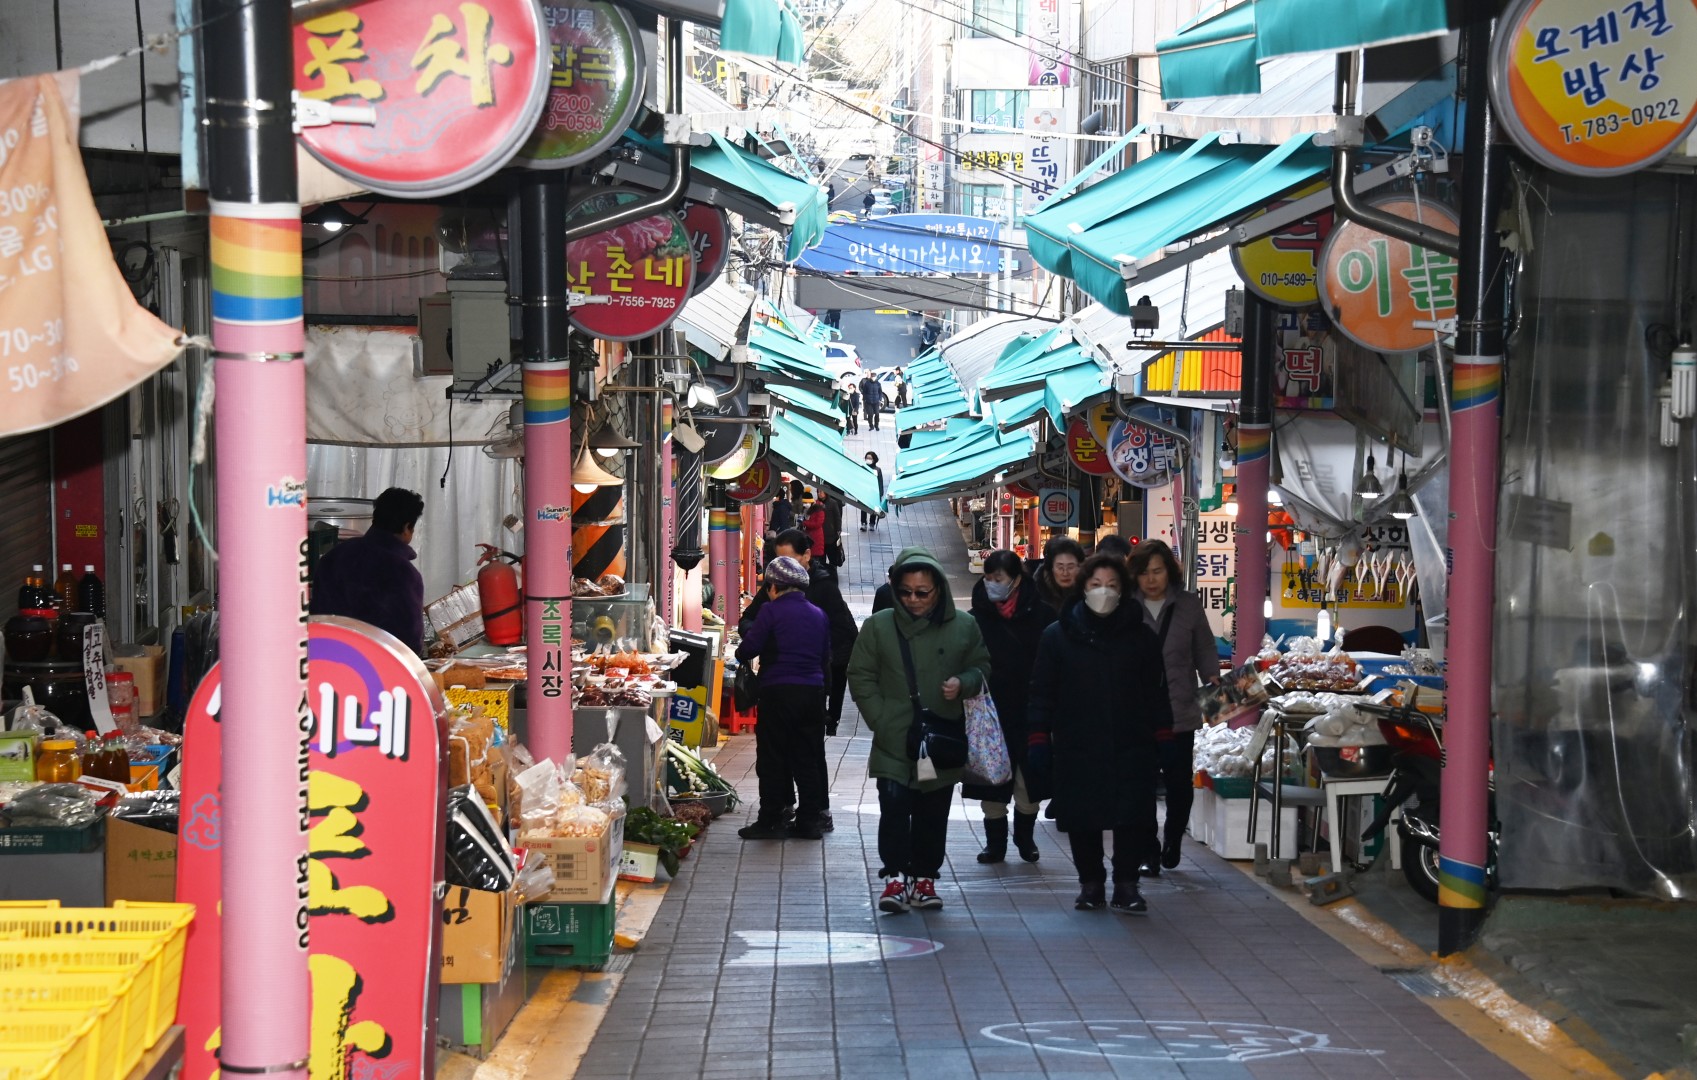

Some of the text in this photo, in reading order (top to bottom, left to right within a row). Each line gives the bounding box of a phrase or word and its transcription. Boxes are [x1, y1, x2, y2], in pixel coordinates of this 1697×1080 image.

[543, 6, 594, 32] 참기름
[1534, 0, 1673, 62] 오계절
[551, 43, 618, 92] 잡곡
[1042, 75, 1056, 85] 2F
[1563, 48, 1665, 106] 밥상
[1561, 98, 1681, 143] T.783-0922
[19, 246, 53, 276] LG
[567, 246, 683, 296] 삼촌네
[1284, 347, 1322, 392] 떡
[1074, 437, 1098, 462] 분
[1125, 446, 1176, 473] 생닭
[1048, 500, 1069, 513] 담배
[540, 600, 564, 698] 초록시장
